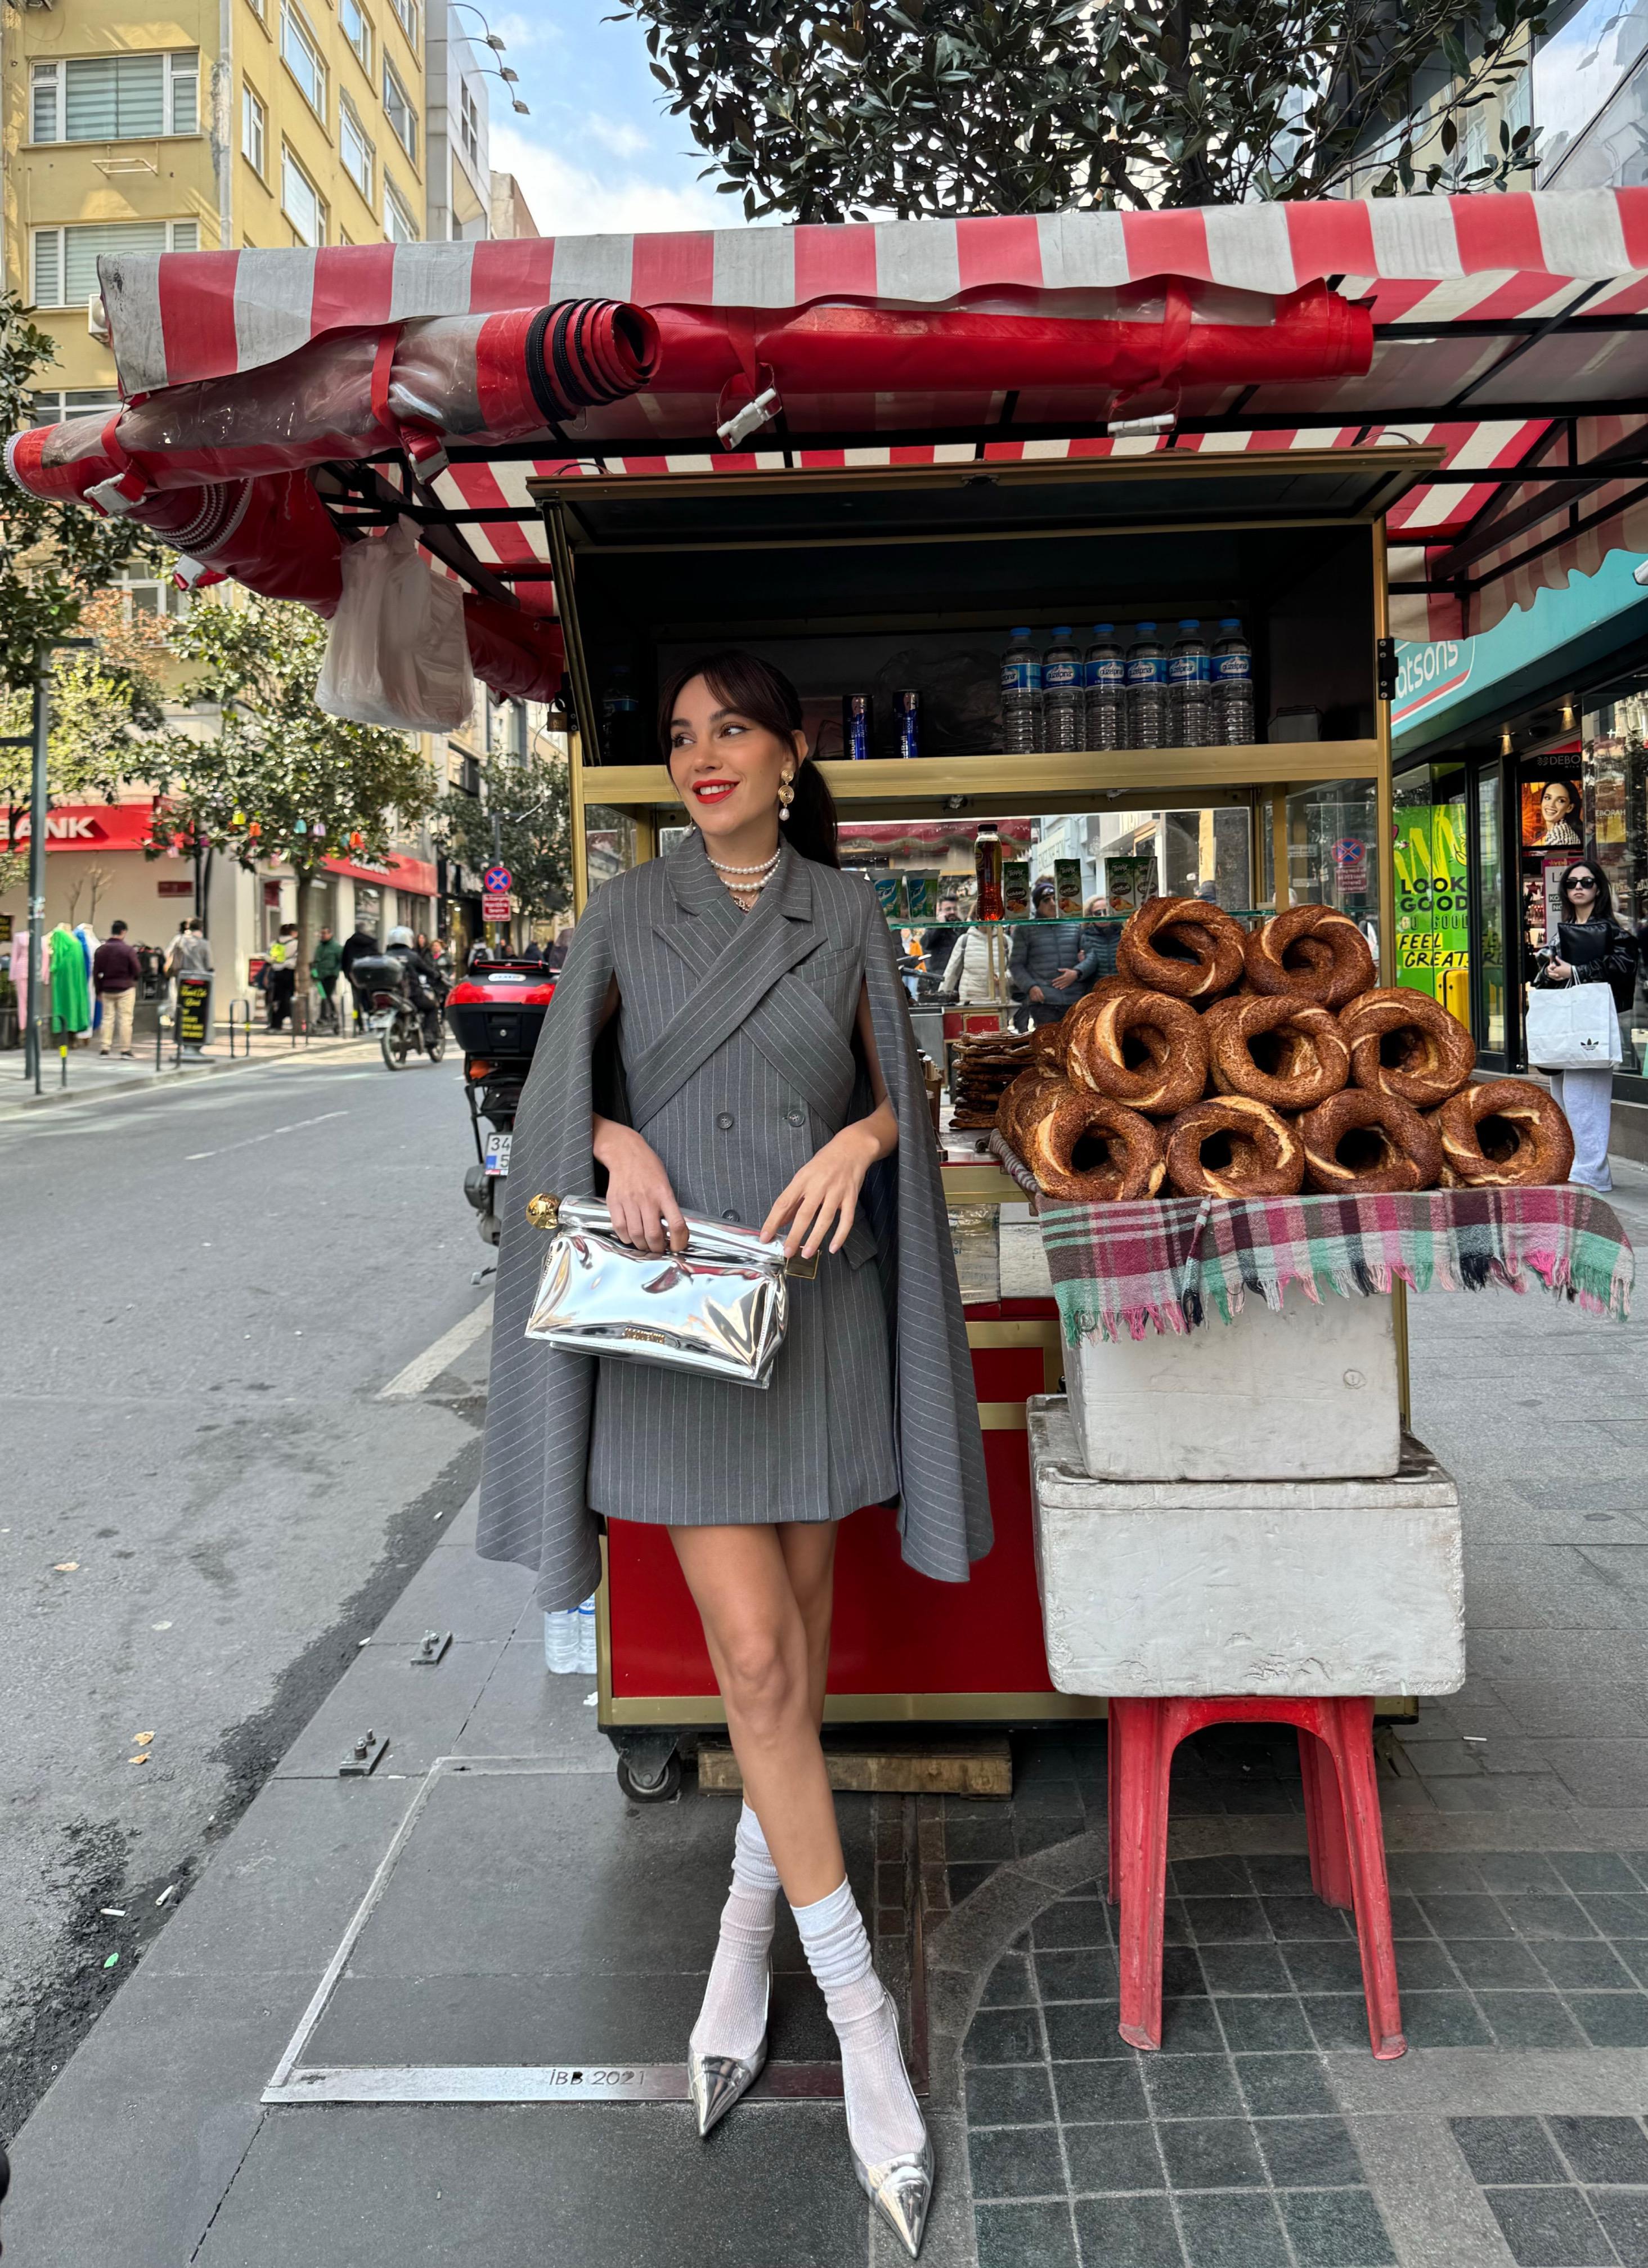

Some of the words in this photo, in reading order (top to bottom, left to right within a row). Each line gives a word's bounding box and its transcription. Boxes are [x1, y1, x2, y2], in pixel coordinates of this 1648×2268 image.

[1401, 877, 1467, 895] LOOK
[1400, 895, 1467, 913] GOOD
[1399, 933, 1441, 950] FEEL
[491, 1137, 510, 1151] 34
[591, 2071, 645, 2085] 2021
